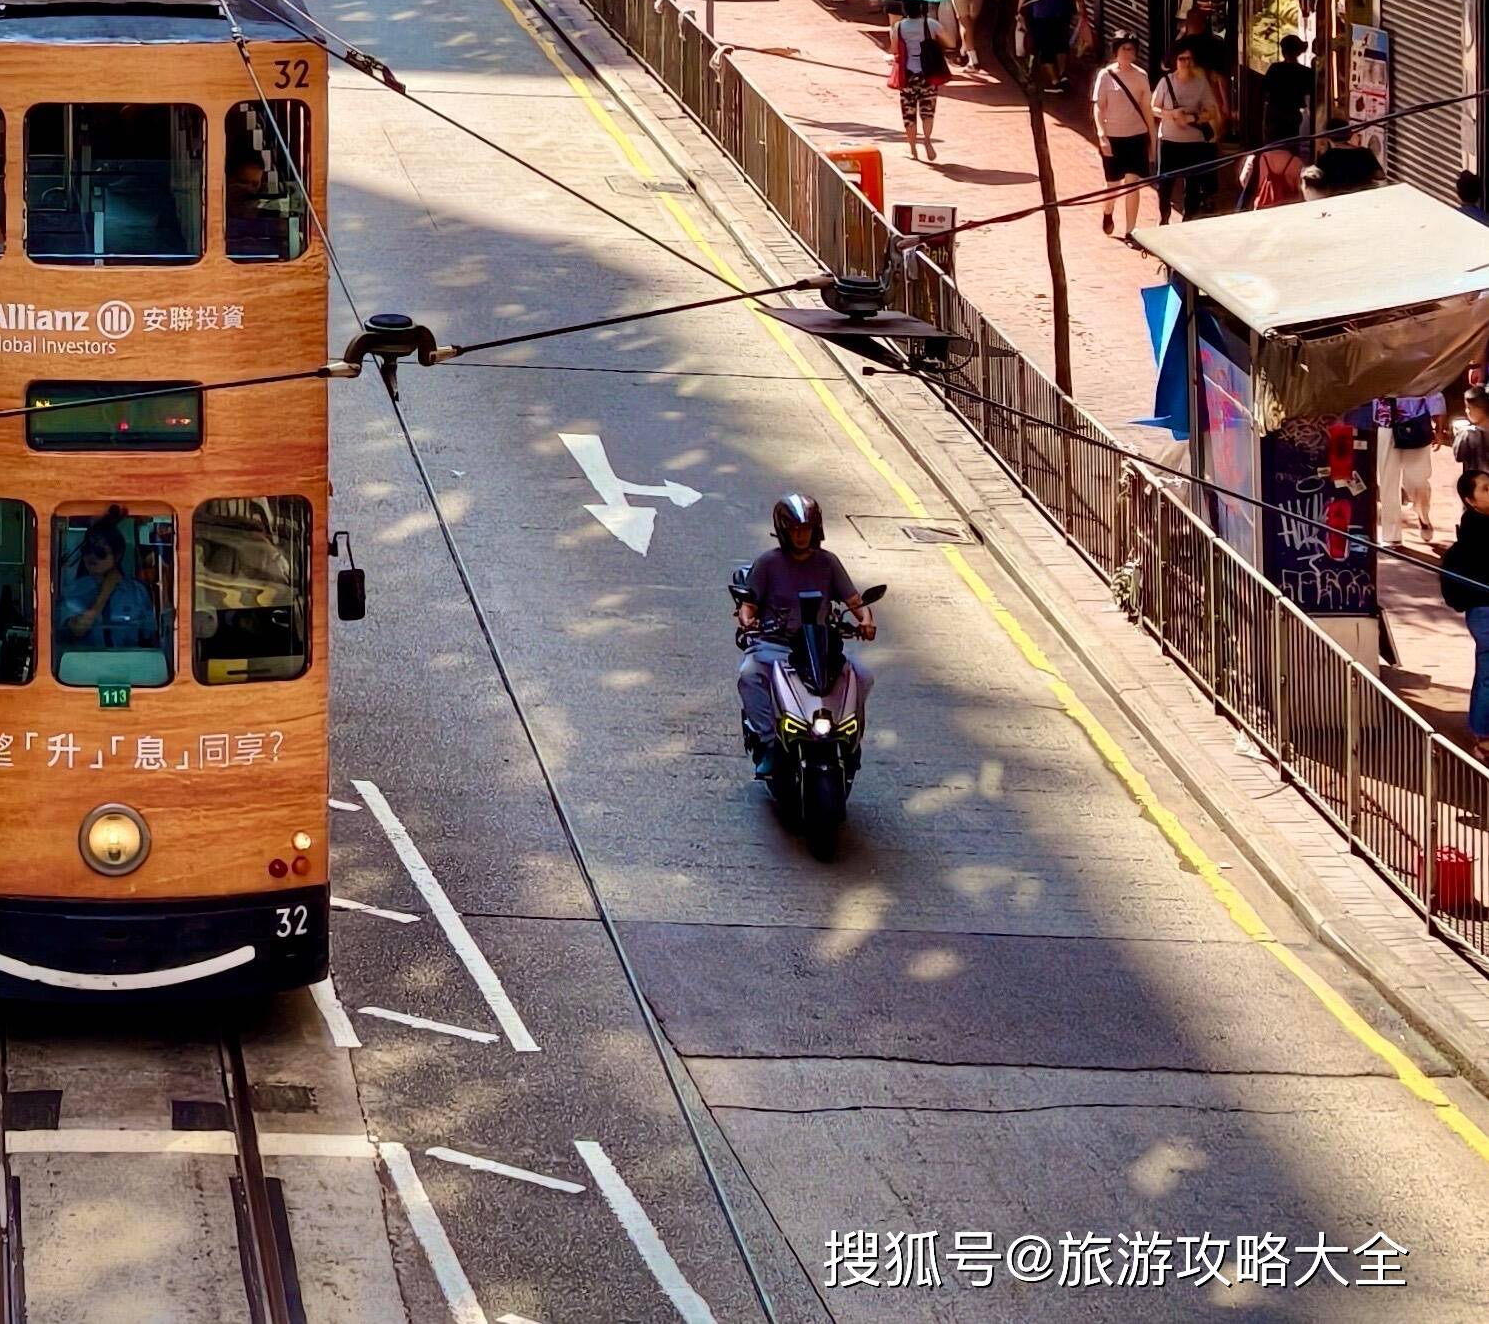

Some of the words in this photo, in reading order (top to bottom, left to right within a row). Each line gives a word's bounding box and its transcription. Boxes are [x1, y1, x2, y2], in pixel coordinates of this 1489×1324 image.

[274, 59, 311, 89] 32
[143, 304, 246, 331] 安聯投資
[41, 335, 117, 355] Investors
[102, 689, 128, 705] 113
[275, 905, 309, 938] 32
